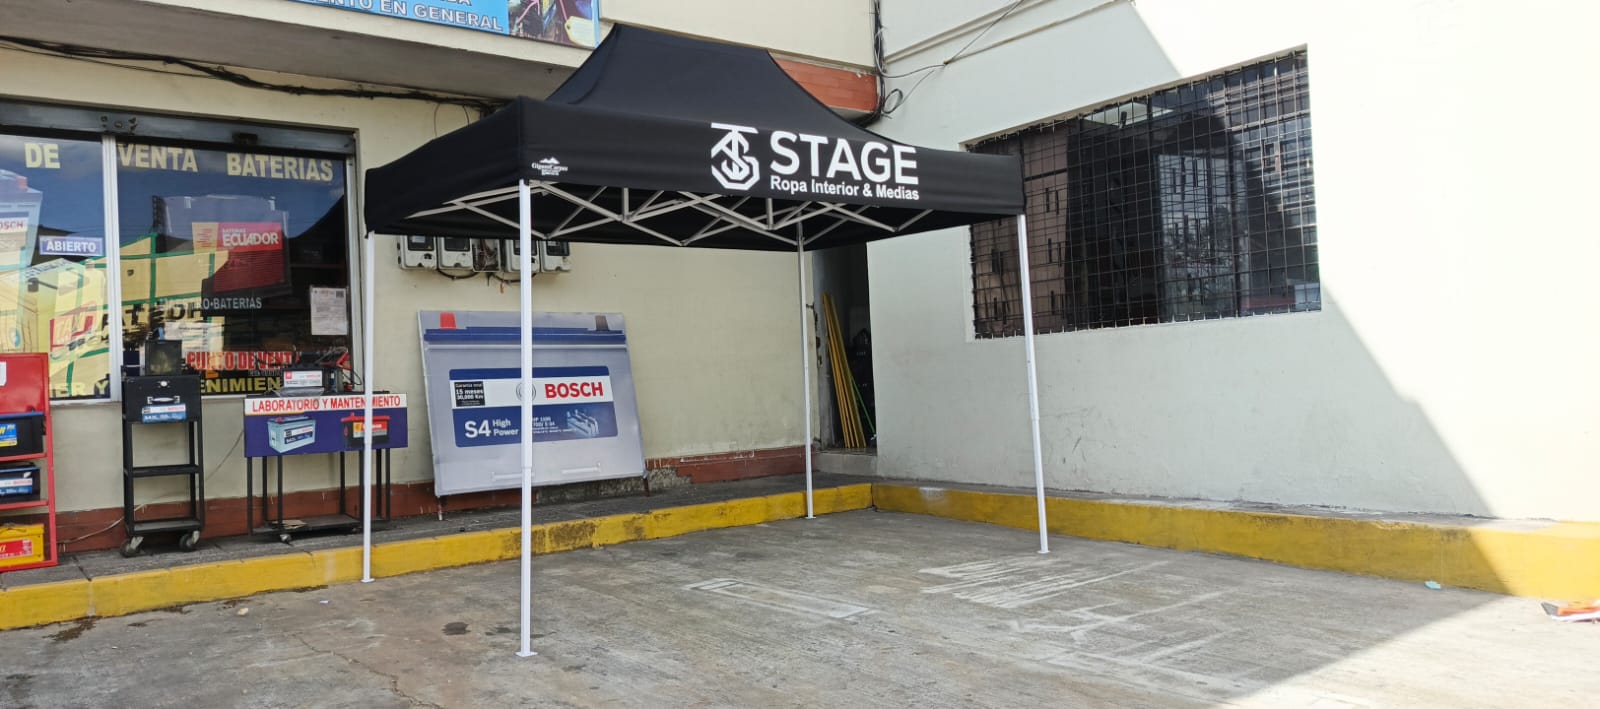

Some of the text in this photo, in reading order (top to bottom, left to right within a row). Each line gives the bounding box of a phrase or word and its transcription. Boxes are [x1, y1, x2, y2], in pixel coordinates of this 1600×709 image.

[380, 0, 407, 15] EN
[414, 4, 503, 31] GENERAL
[25, 143, 334, 181] DE VENTA BATERIAS
[770, 130, 919, 186] STAGE
[770, 175, 920, 201] Ropa Interior & Medias
[0, 221, 24, 230] SCH
[46, 240, 97, 252] ABIERTO
[223, 232, 279, 247] ECUADOR
[544, 381, 604, 399] BOSCH
[252, 395, 401, 413] LABORATORIO Y MANTENMIENTO
[464, 418, 512, 438] S4 High
[493, 428, 519, 437] Power
